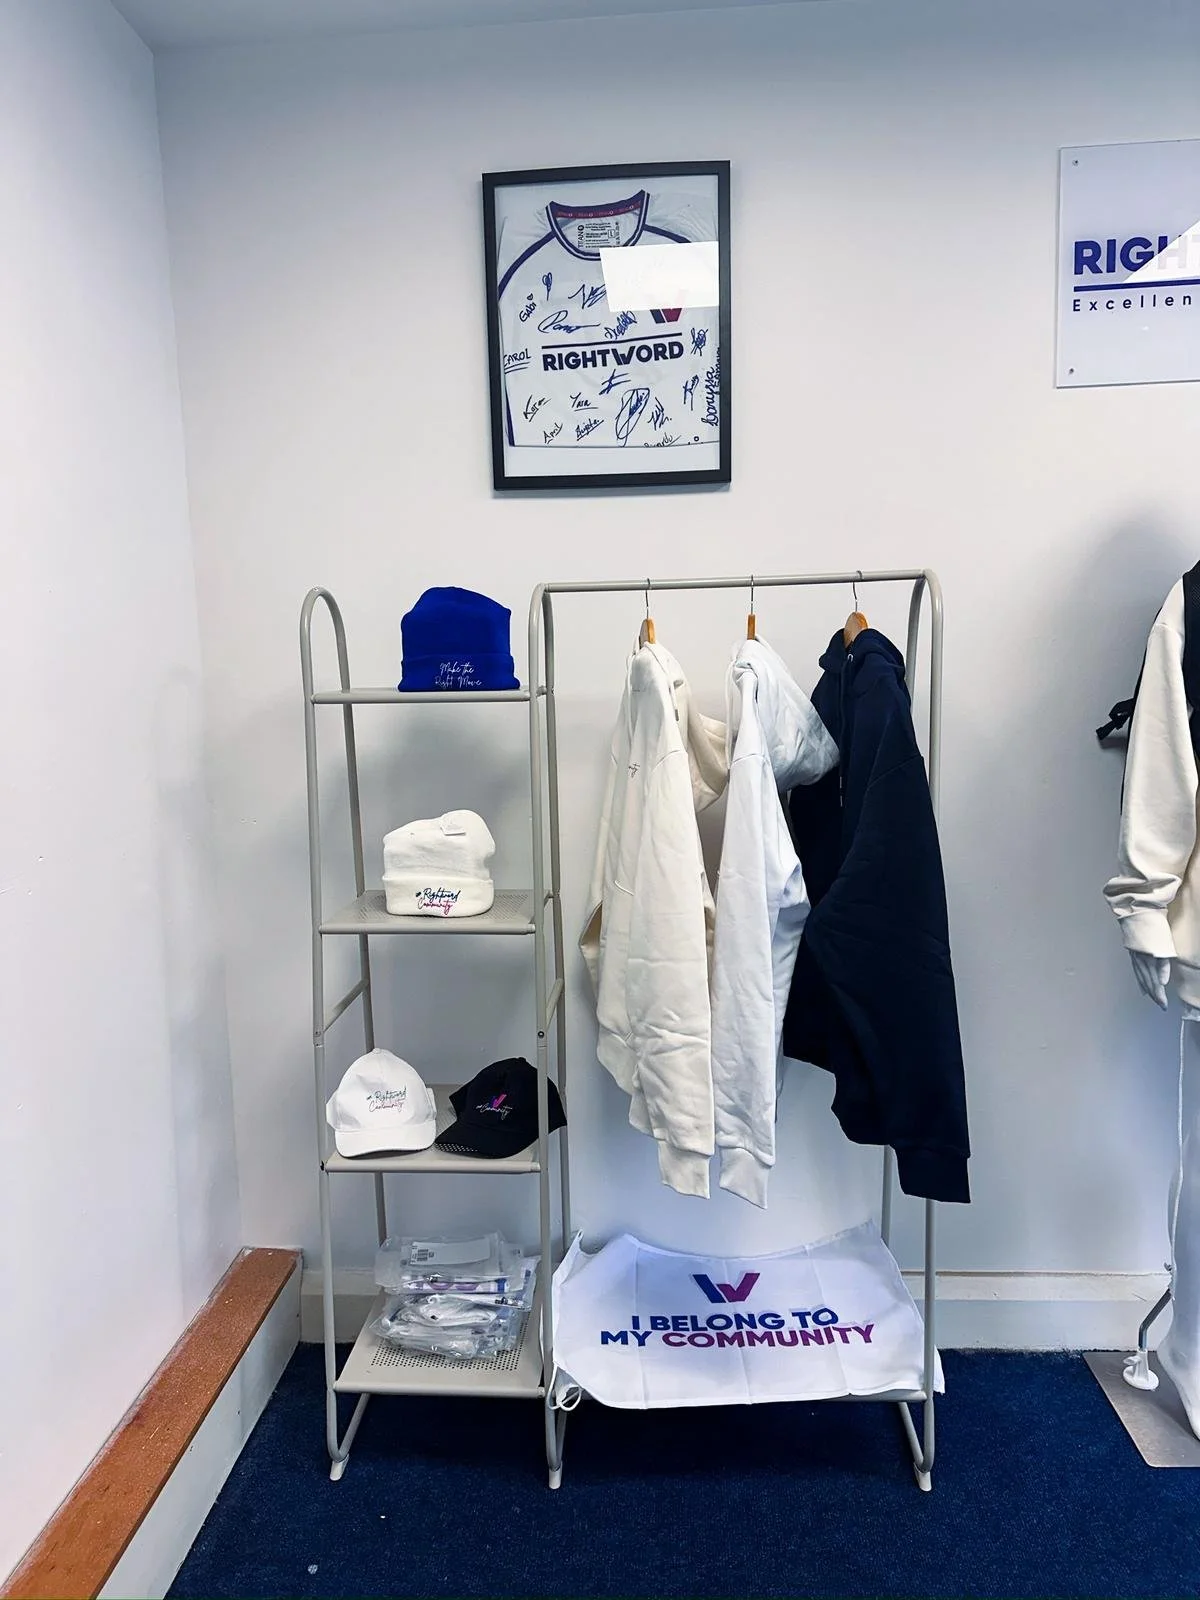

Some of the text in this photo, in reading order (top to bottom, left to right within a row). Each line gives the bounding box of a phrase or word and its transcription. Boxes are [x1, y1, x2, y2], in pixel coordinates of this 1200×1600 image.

[542, 341, 684, 372] RIGHTWORD
[632, 1307, 838, 1331] I BELONG TO
[600, 1324, 875, 1348] MY COMMUNITY
